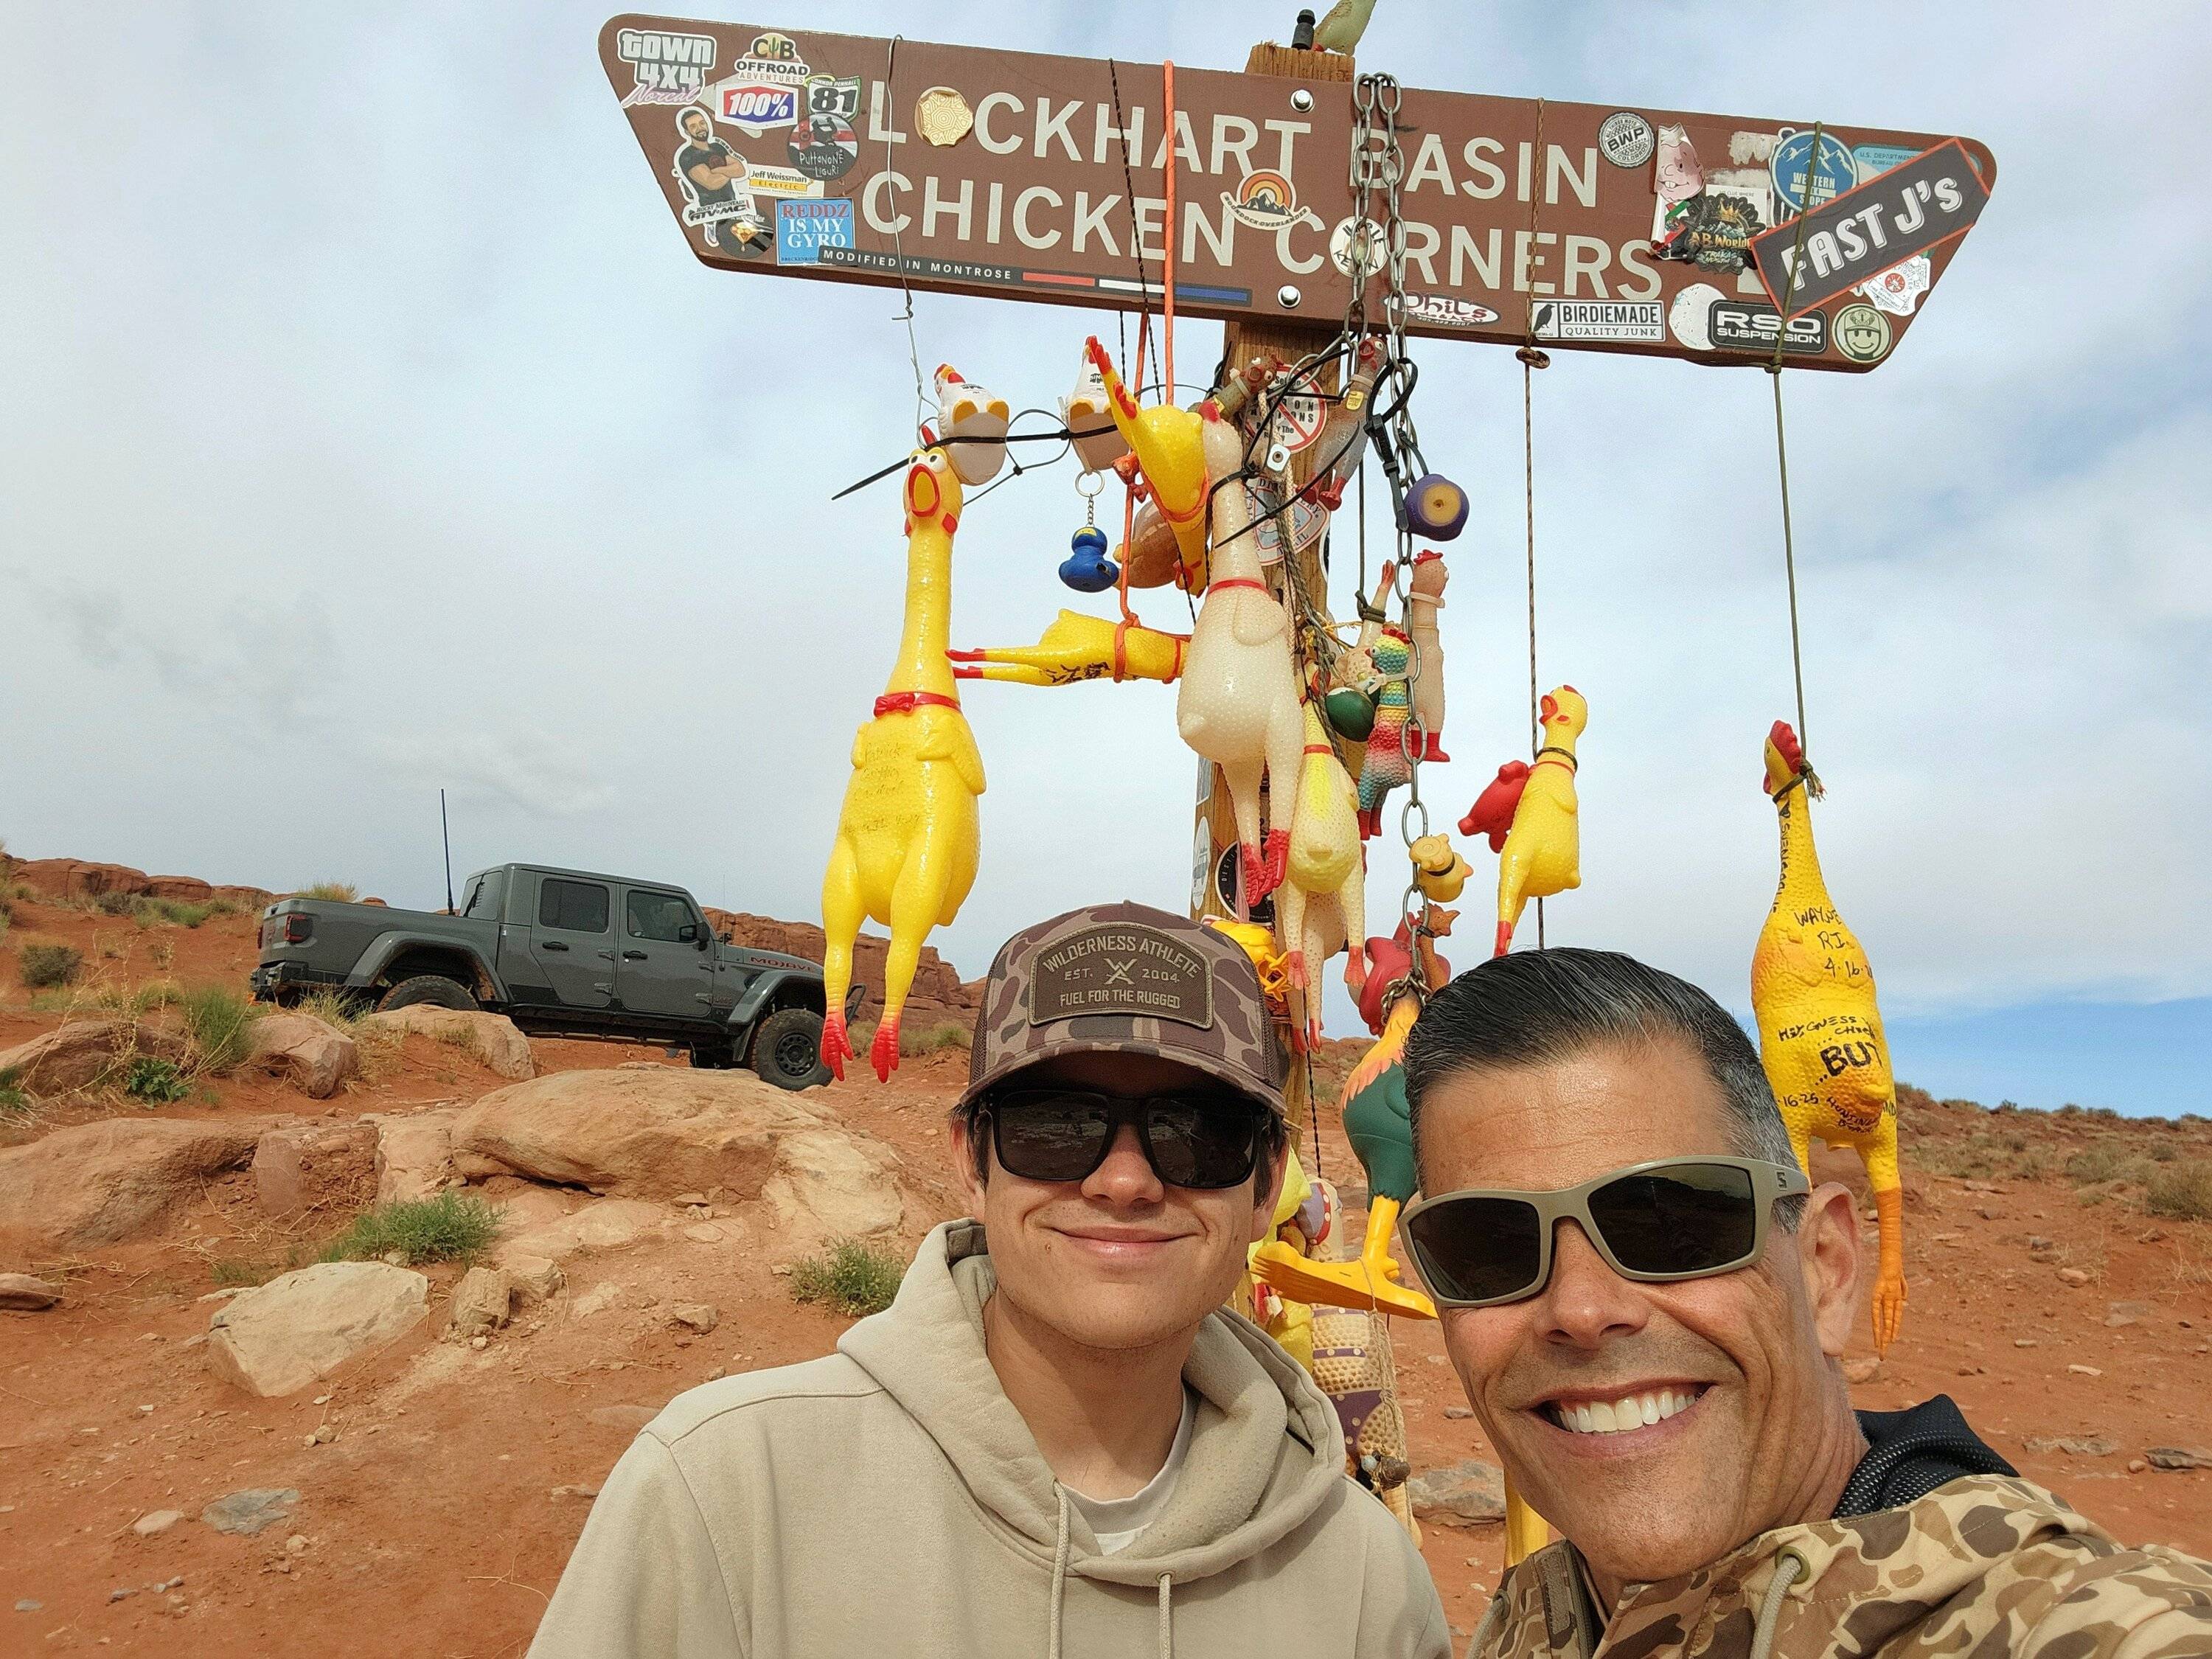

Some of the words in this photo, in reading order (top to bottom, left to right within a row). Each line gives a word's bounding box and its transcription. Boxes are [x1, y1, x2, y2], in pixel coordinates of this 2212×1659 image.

[736, 61, 808, 75] OFFROAD
[740, 73, 804, 83] ADVENTURES
[729, 92, 789, 117] 100%
[812, 88, 857, 113] 81
[868, 80, 1311, 180] LCKHART
[1607, 127, 1644, 152] BWP
[1618, 143, 1648, 161] COLORADO
[751, 170, 766, 179] Jeff
[767, 172, 807, 183] Weissman
[1793, 172, 1835, 189] WETERN
[759, 181, 798, 190] Electric
[1799, 194, 1826, 206] SOPE
[782, 204, 850, 218] REDDZ
[789, 218, 807, 233] IS
[813, 218, 844, 234] MY
[787, 233, 846, 248] GYRO
[861, 170, 1235, 266] CHICKEN
[1276, 211, 1663, 301] CRNERS
[1780, 201, 1887, 292] FAST
[824, 249, 897, 268] MODIFIED
[905, 260, 920, 270] IN
[931, 262, 1012, 279] MONTROSE
[1563, 305, 1658, 323] BIRDIEMADE
[1717, 310, 1821, 333] RSO
[1565, 327, 1619, 335] QUALITY
[1624, 328, 1657, 336] JUNK
[1717, 327, 1821, 344] SUSPENSION
[1042, 935, 1136, 973] WILDERNESS
[1138, 937, 1201, 978] ATHLETE
[1064, 968, 1093, 981] EST.
[1142, 968, 1180, 983] 2004
[1060, 992, 1085, 1007] FUEL
[1088, 990, 1110, 1003] FOR
[1112, 989, 1134, 1003] THE
[1138, 991, 1180, 1009] RUGGED
